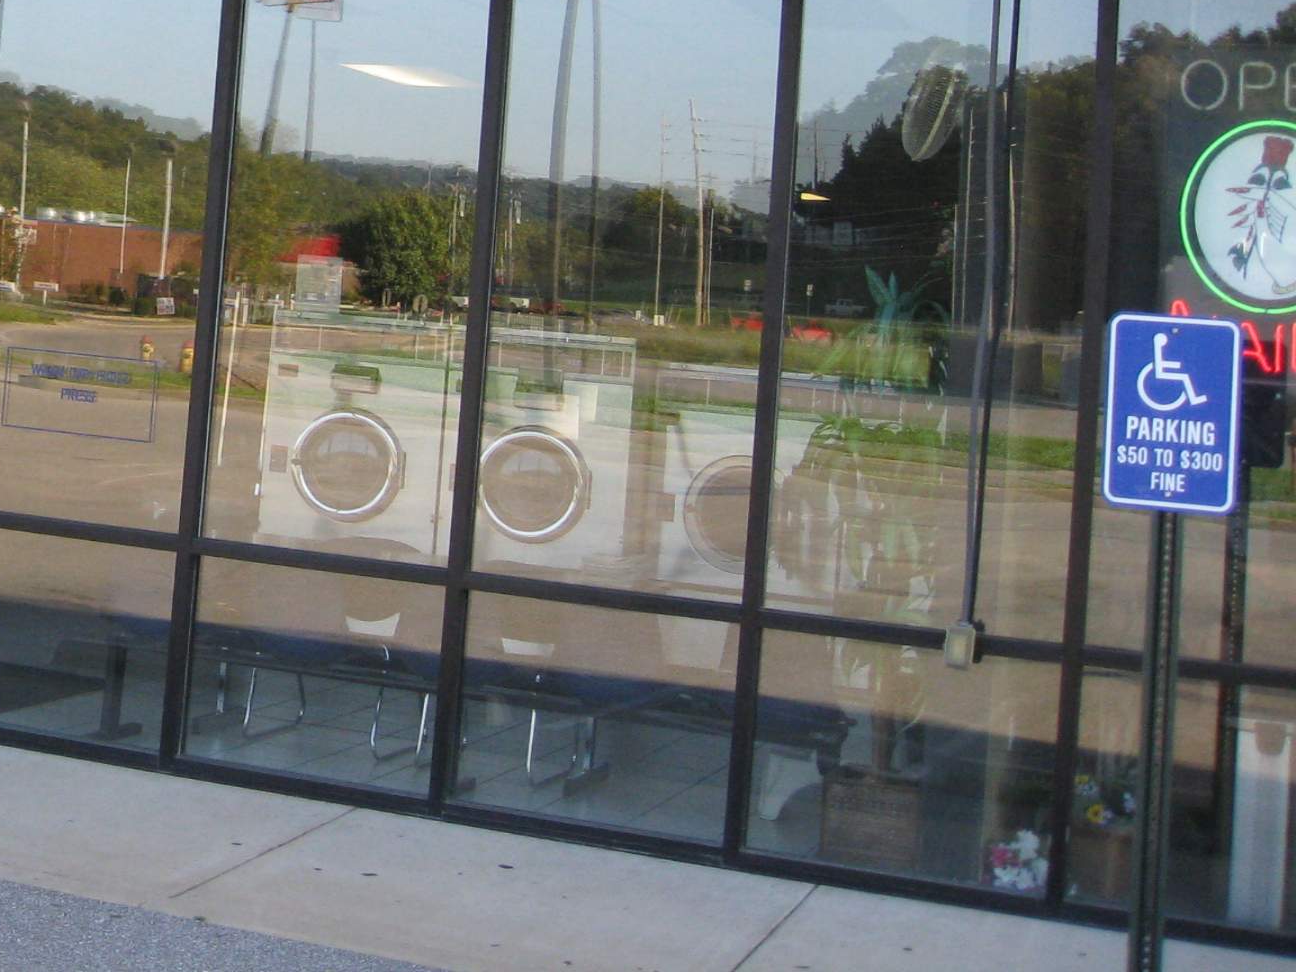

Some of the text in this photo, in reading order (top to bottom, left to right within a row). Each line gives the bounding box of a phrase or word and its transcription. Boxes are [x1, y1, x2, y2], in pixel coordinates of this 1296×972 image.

[1125, 415, 1216, 447] PARKING
[1116, 444, 1223, 472] $50 TO $300
[1150, 471, 1186, 493] FINE
